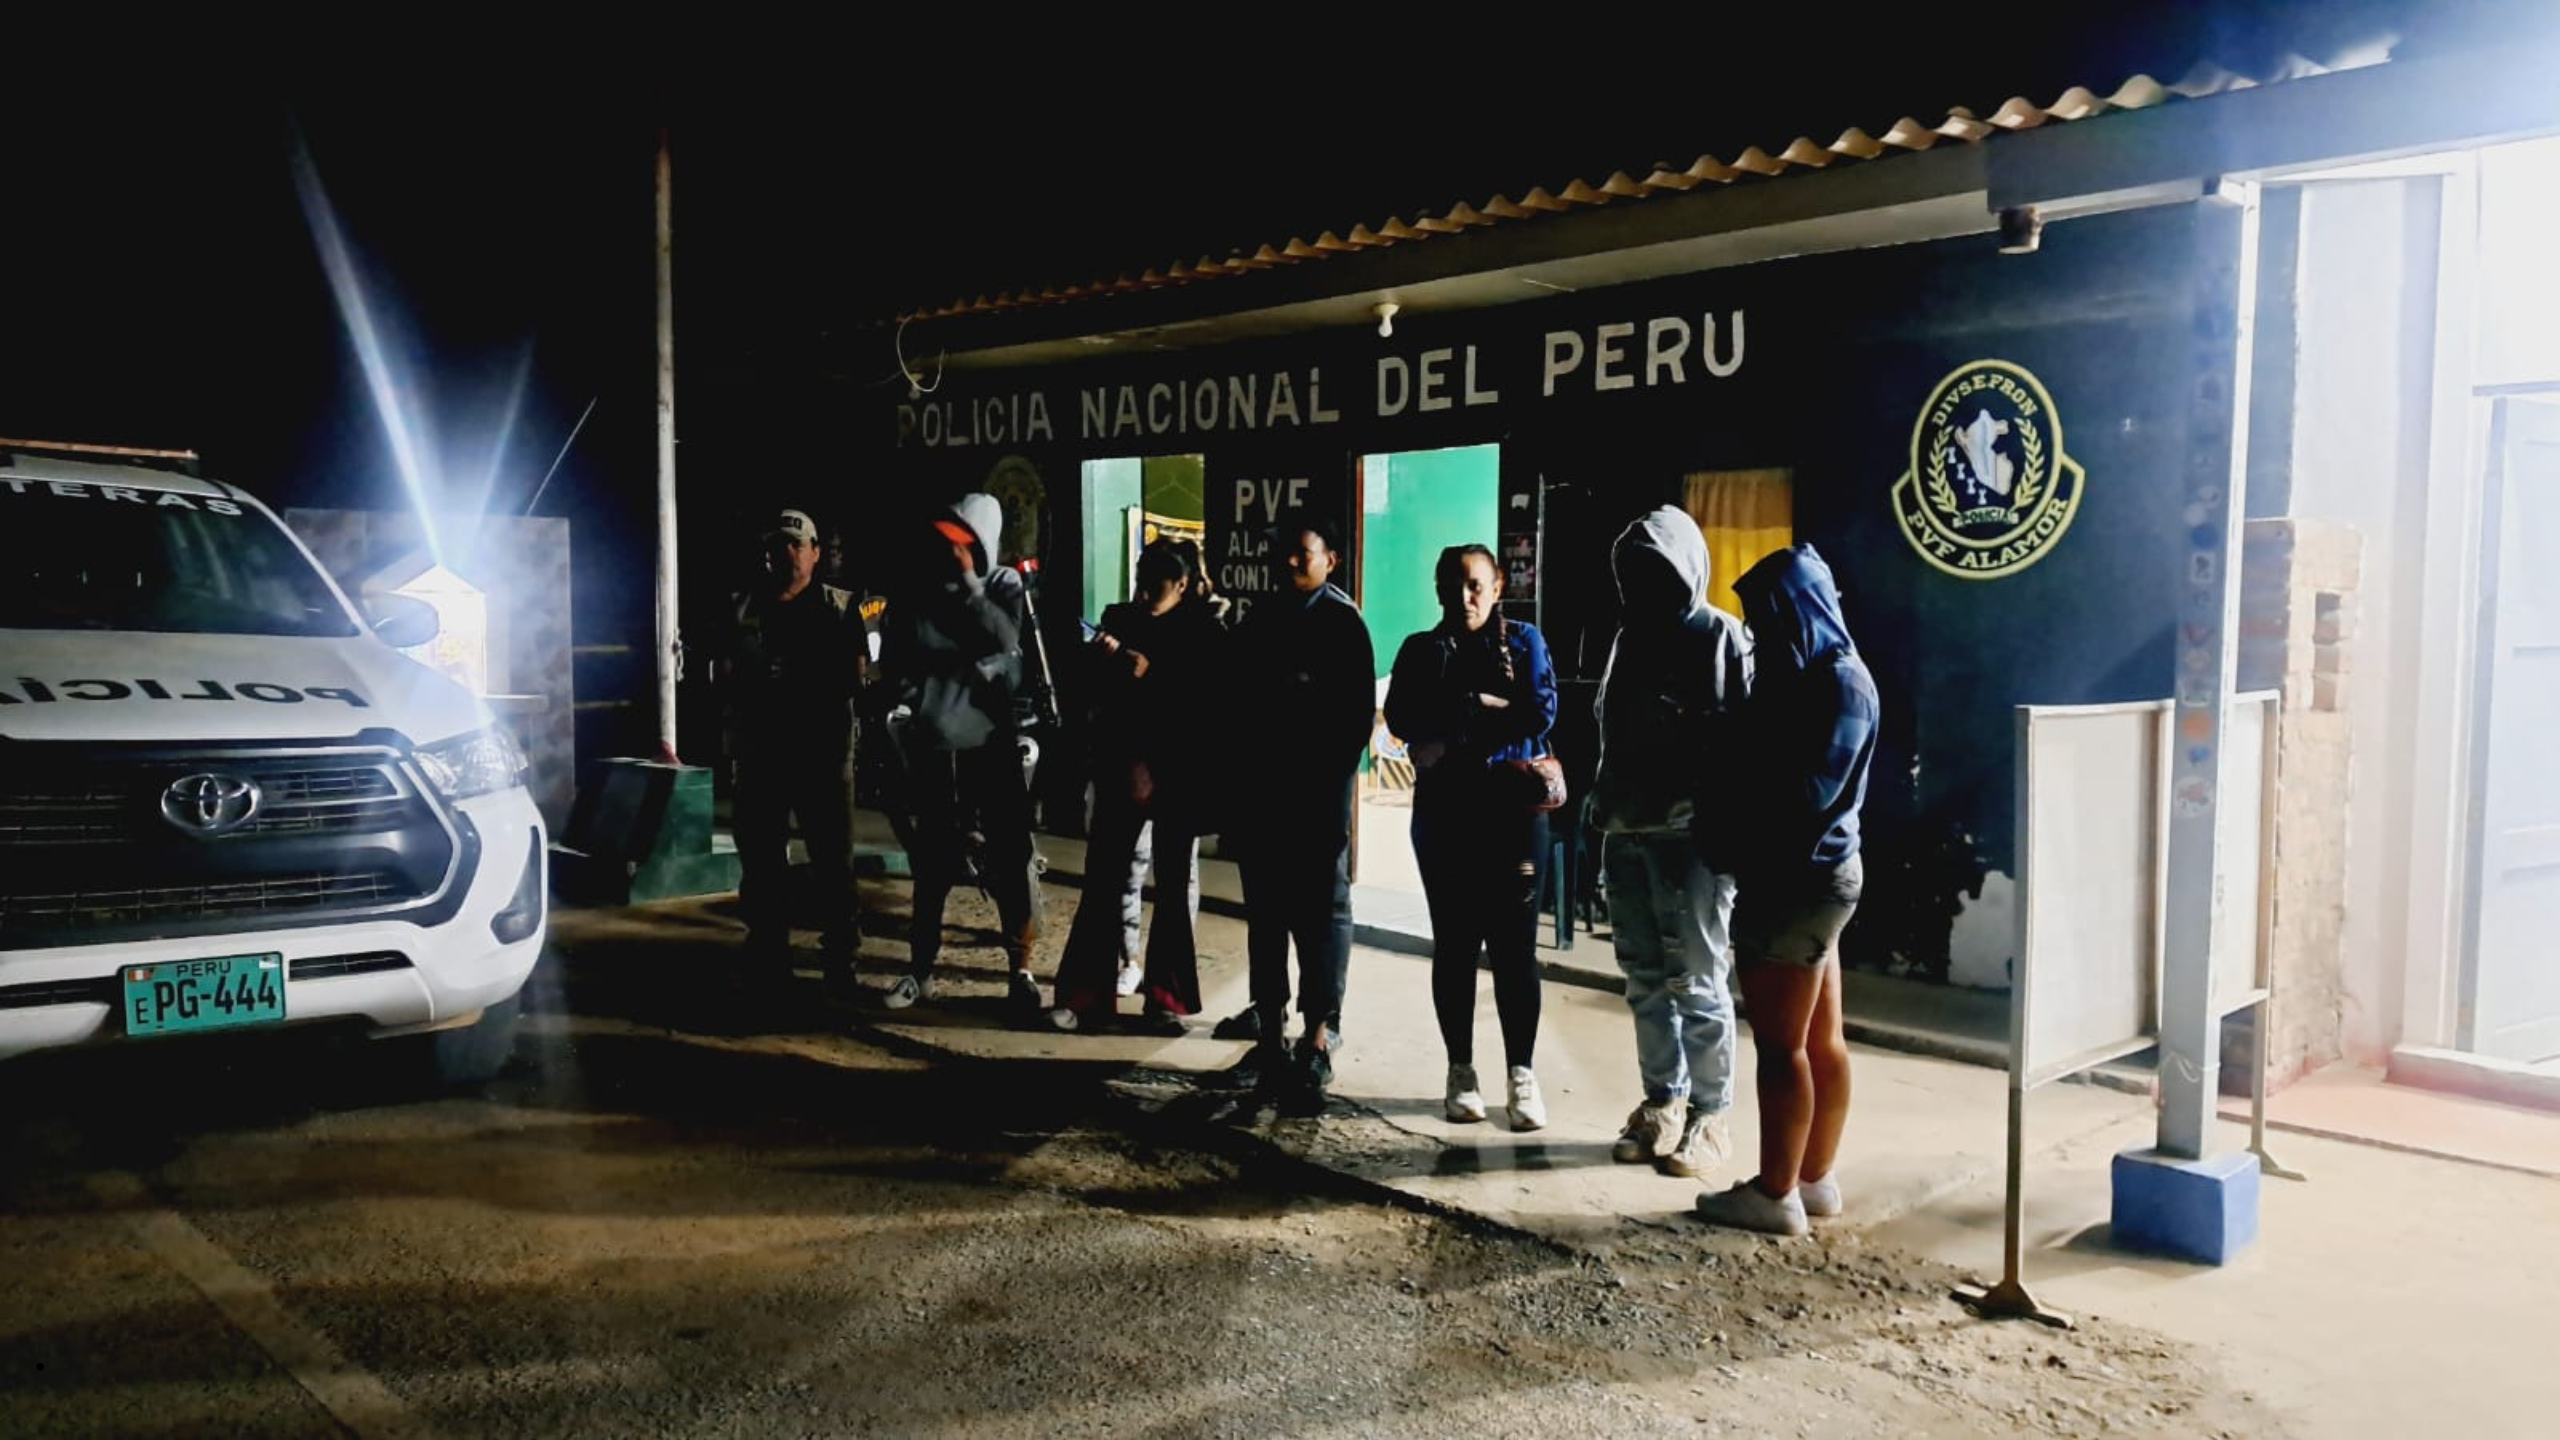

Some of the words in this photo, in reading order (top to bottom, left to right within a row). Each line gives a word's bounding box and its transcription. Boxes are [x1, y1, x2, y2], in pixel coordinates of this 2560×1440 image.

[896, 391, 1054, 448] POLICIA
[1082, 367, 1340, 439] NACIONAL
[1377, 345, 1498, 417] DEL
[1543, 309, 1745, 397] PERU
[1932, 373, 2038, 427] DIVSEFRON
[0, 478, 242, 516] TERAS
[1907, 511, 1956, 558] PVF
[1958, 498, 2068, 568] ALAMOR
[176, 960, 231, 977] PERU
[153, 971, 277, 1022] PG-444
